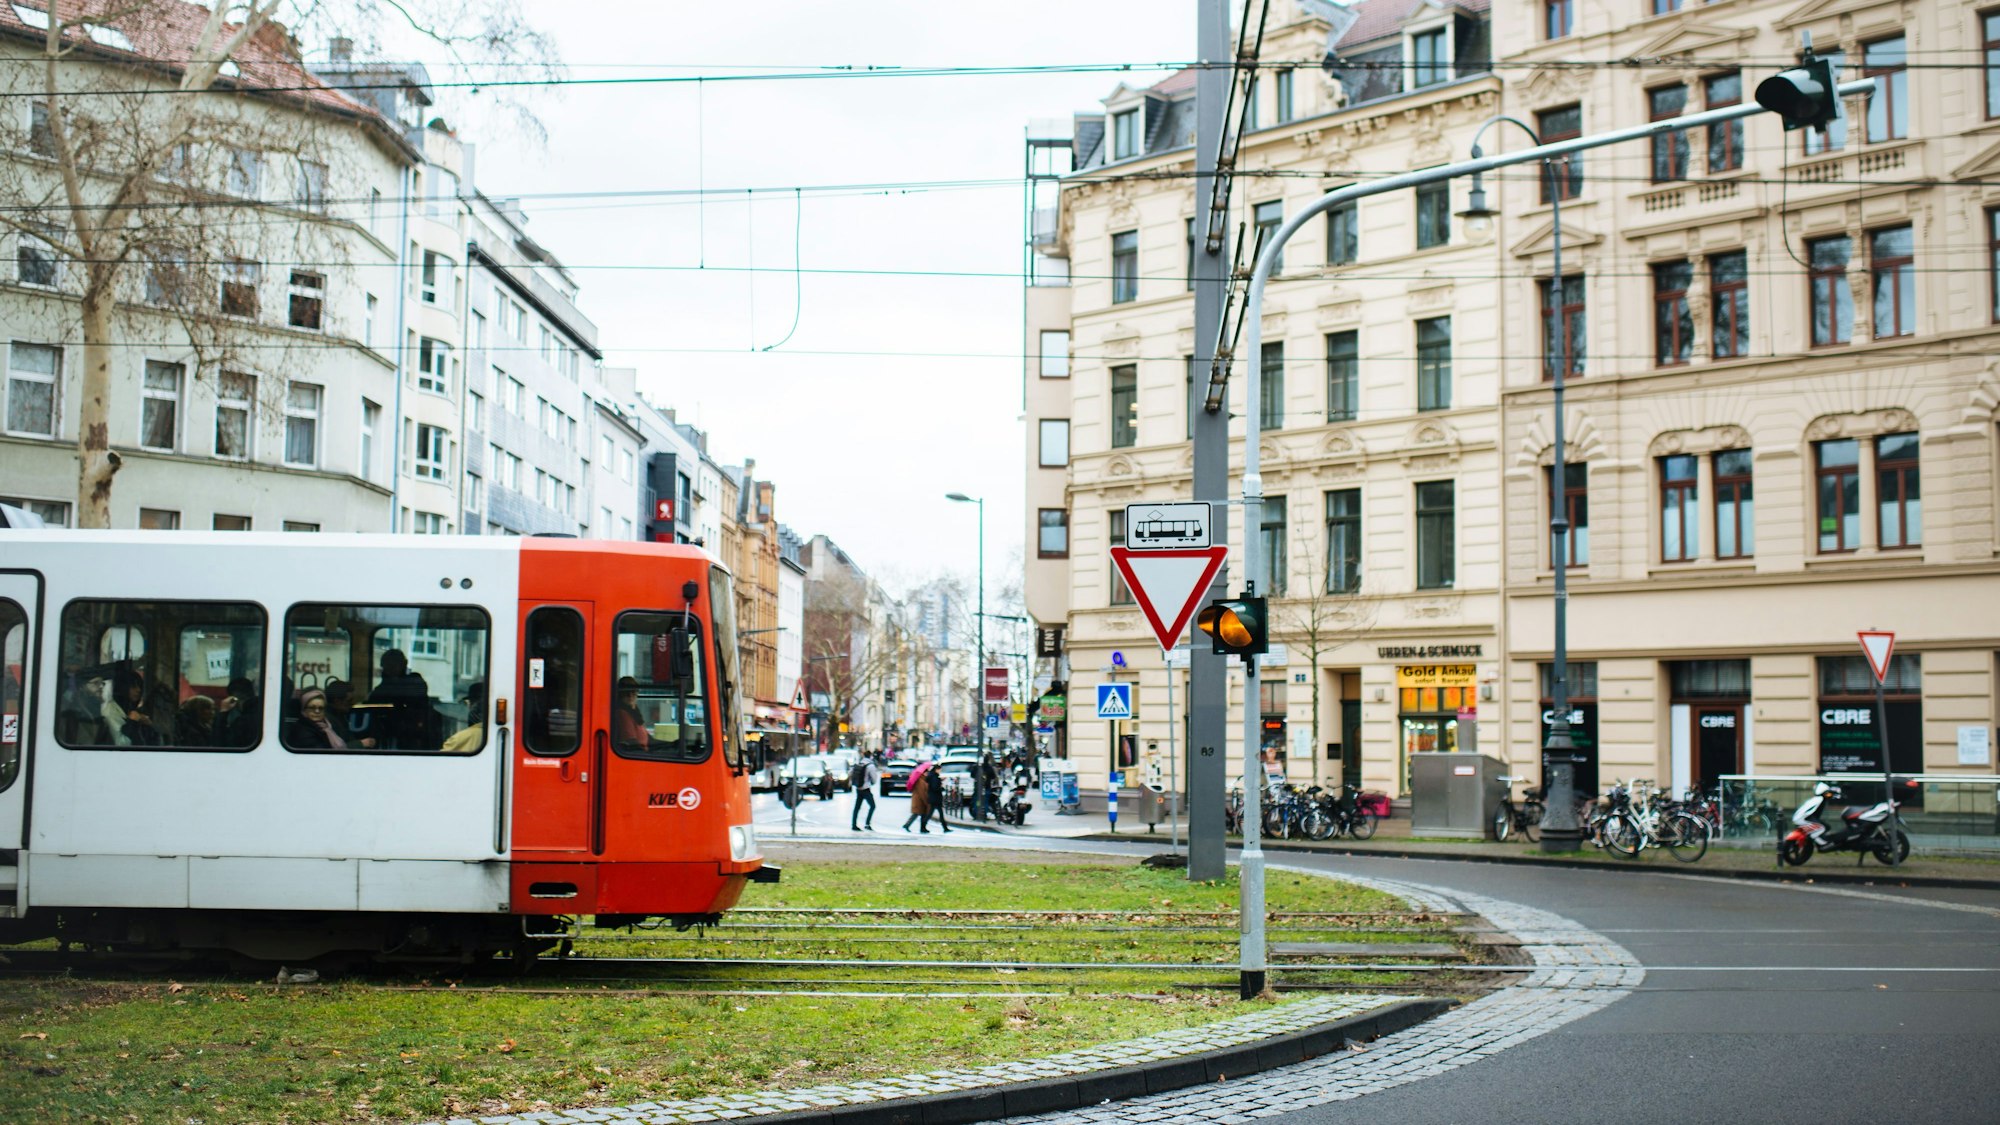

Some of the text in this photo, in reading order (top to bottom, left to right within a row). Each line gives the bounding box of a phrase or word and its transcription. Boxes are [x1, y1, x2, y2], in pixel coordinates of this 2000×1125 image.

[1378, 647, 1416, 658] UHREN
[1427, 645, 1483, 657] SCHMUCK
[1404, 666, 1436, 677] Gold
[988, 716, 997, 728] P
[1701, 716, 1735, 728] CBRE
[1822, 709, 1872, 725] CBRE
[649, 793, 678, 807] KVB
